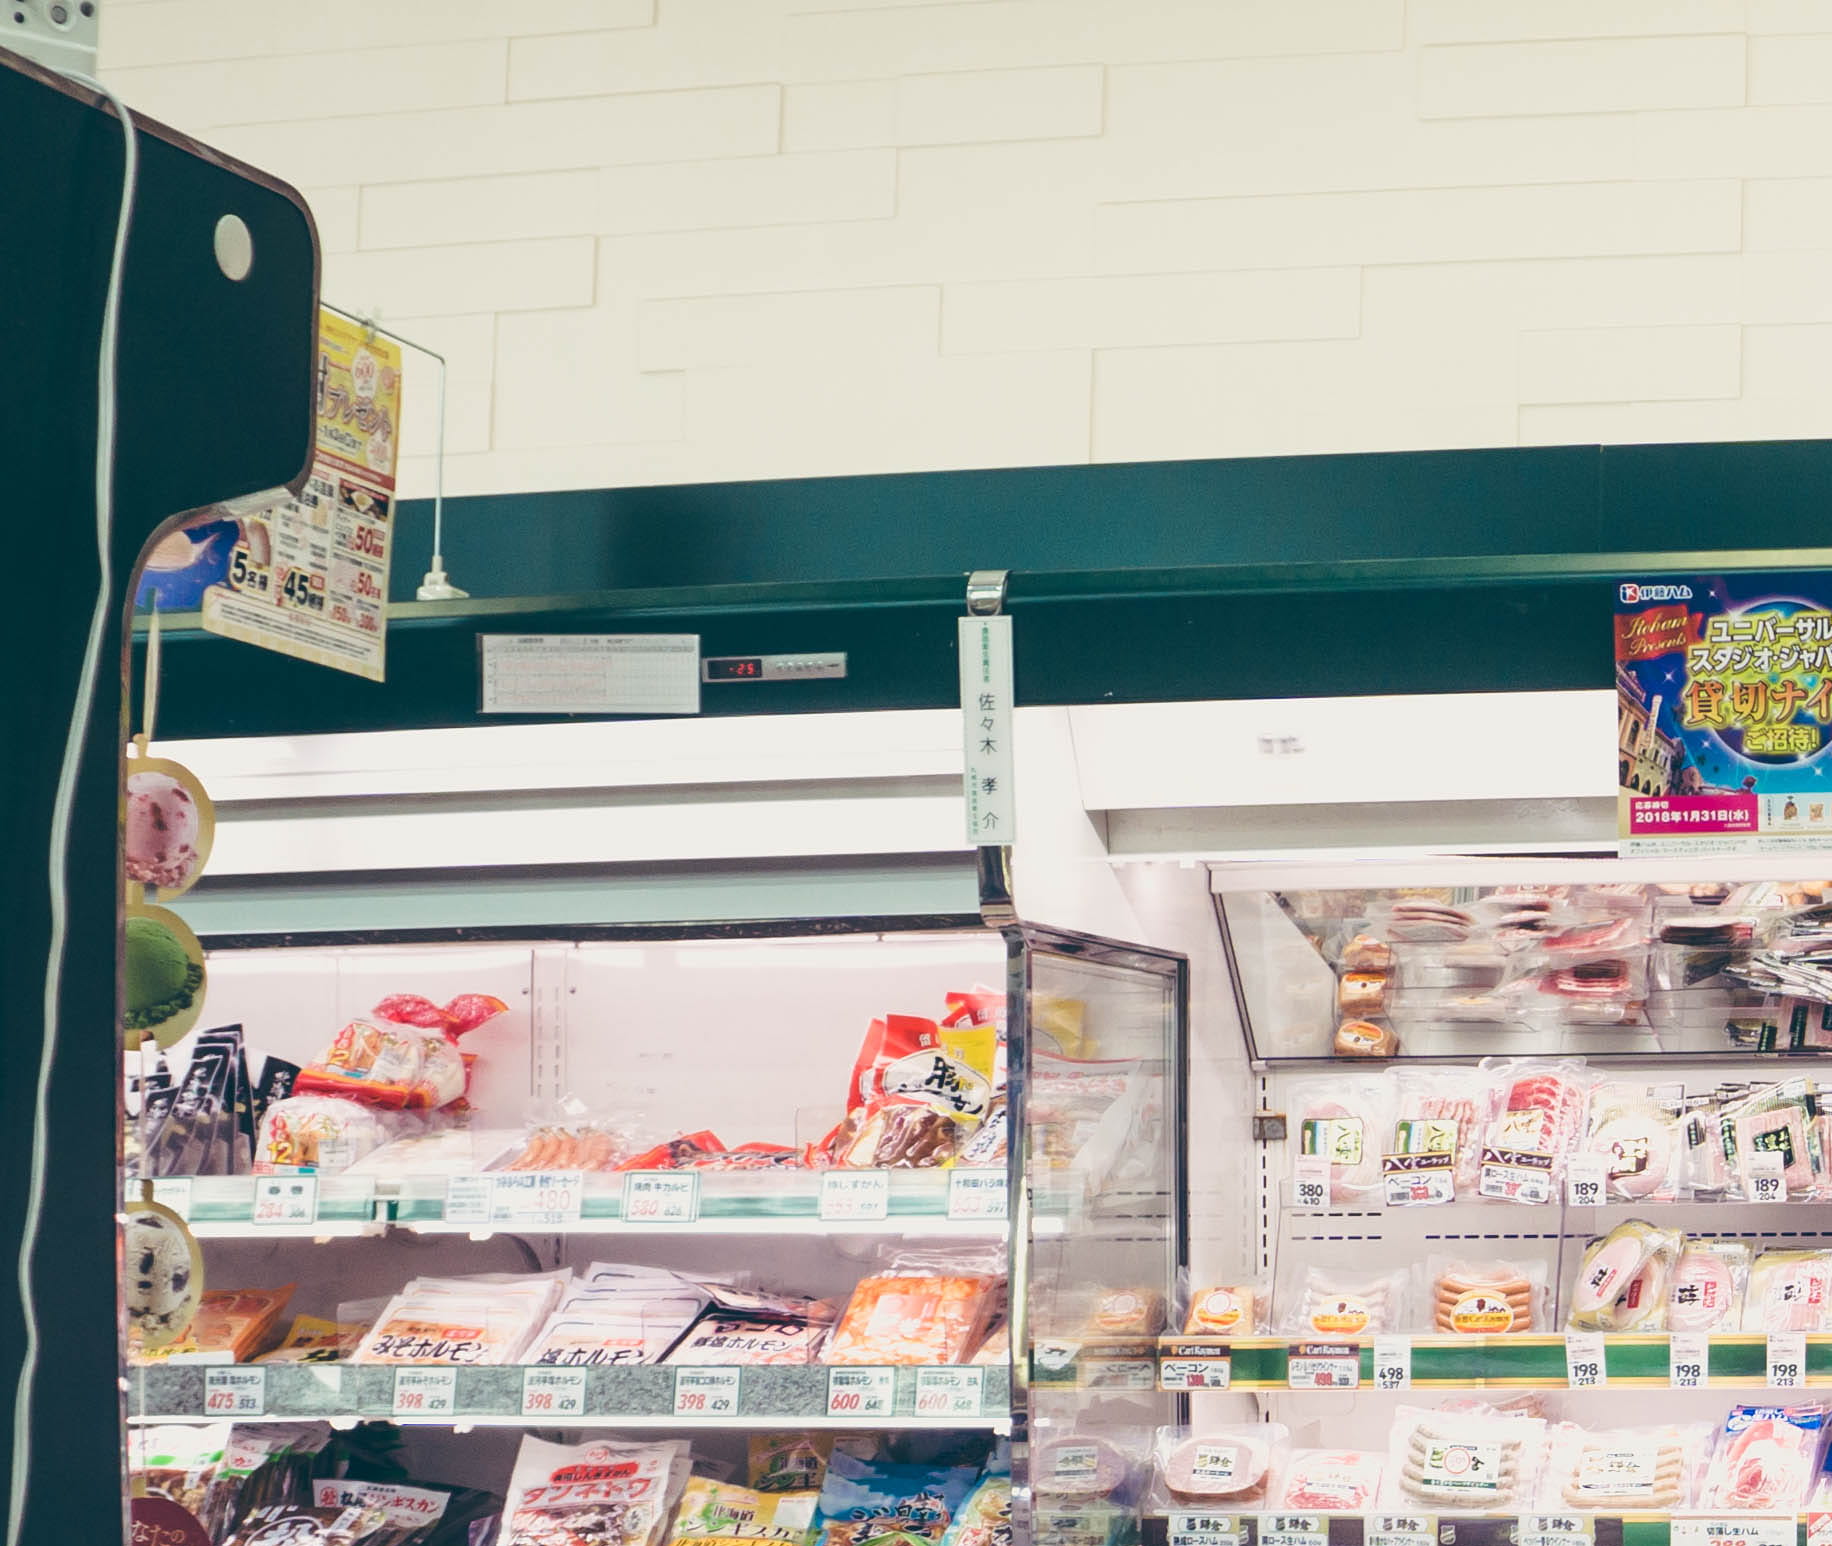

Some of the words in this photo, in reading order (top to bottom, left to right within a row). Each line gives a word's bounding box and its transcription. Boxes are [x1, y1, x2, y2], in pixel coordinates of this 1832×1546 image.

[1298, 1183, 1324, 1198] 380
[1573, 1182, 1600, 1197] 189
[1378, 1366, 1403, 1382] 498
[1572, 1363, 1599, 1379] 198
[396, 1394, 423, 1409] 398
